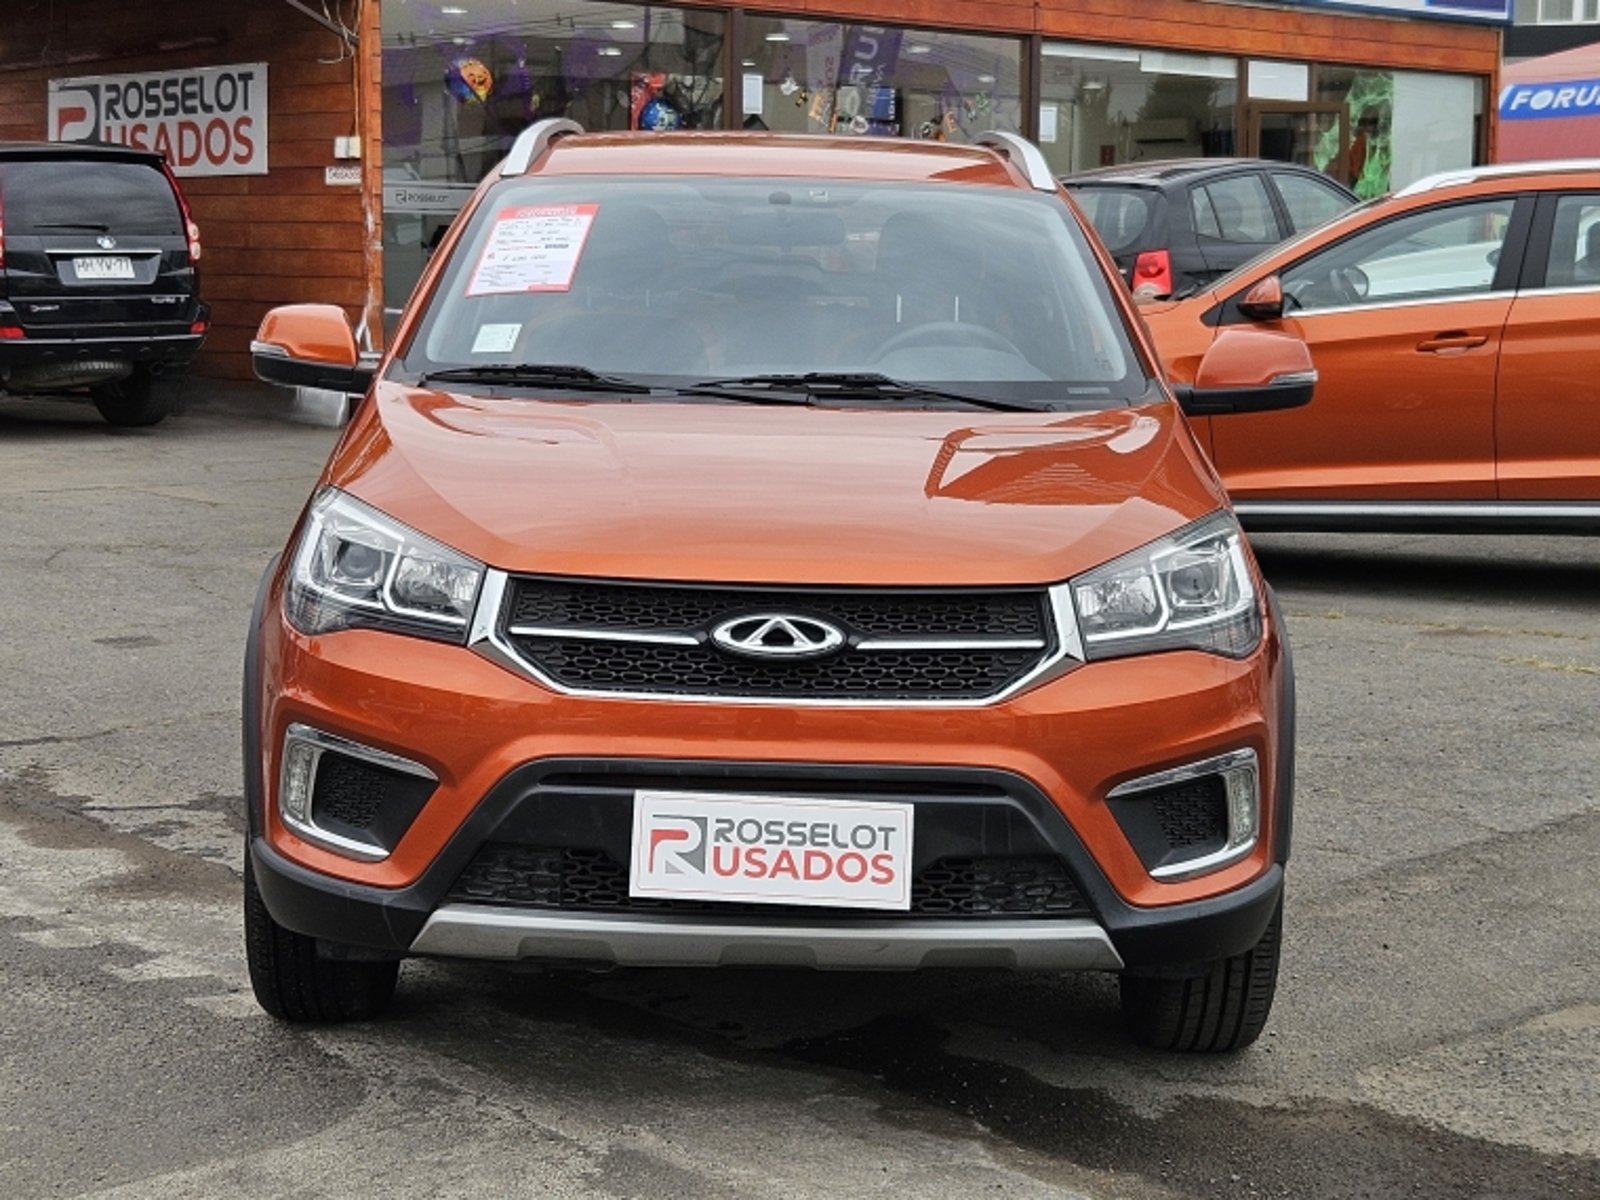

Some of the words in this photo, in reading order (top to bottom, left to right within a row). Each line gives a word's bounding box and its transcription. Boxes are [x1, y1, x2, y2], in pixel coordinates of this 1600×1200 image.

[104, 72, 254, 121] ROSSELOT
[713, 818, 896, 851] ROSSELOT
[712, 846, 895, 885] USADOS
